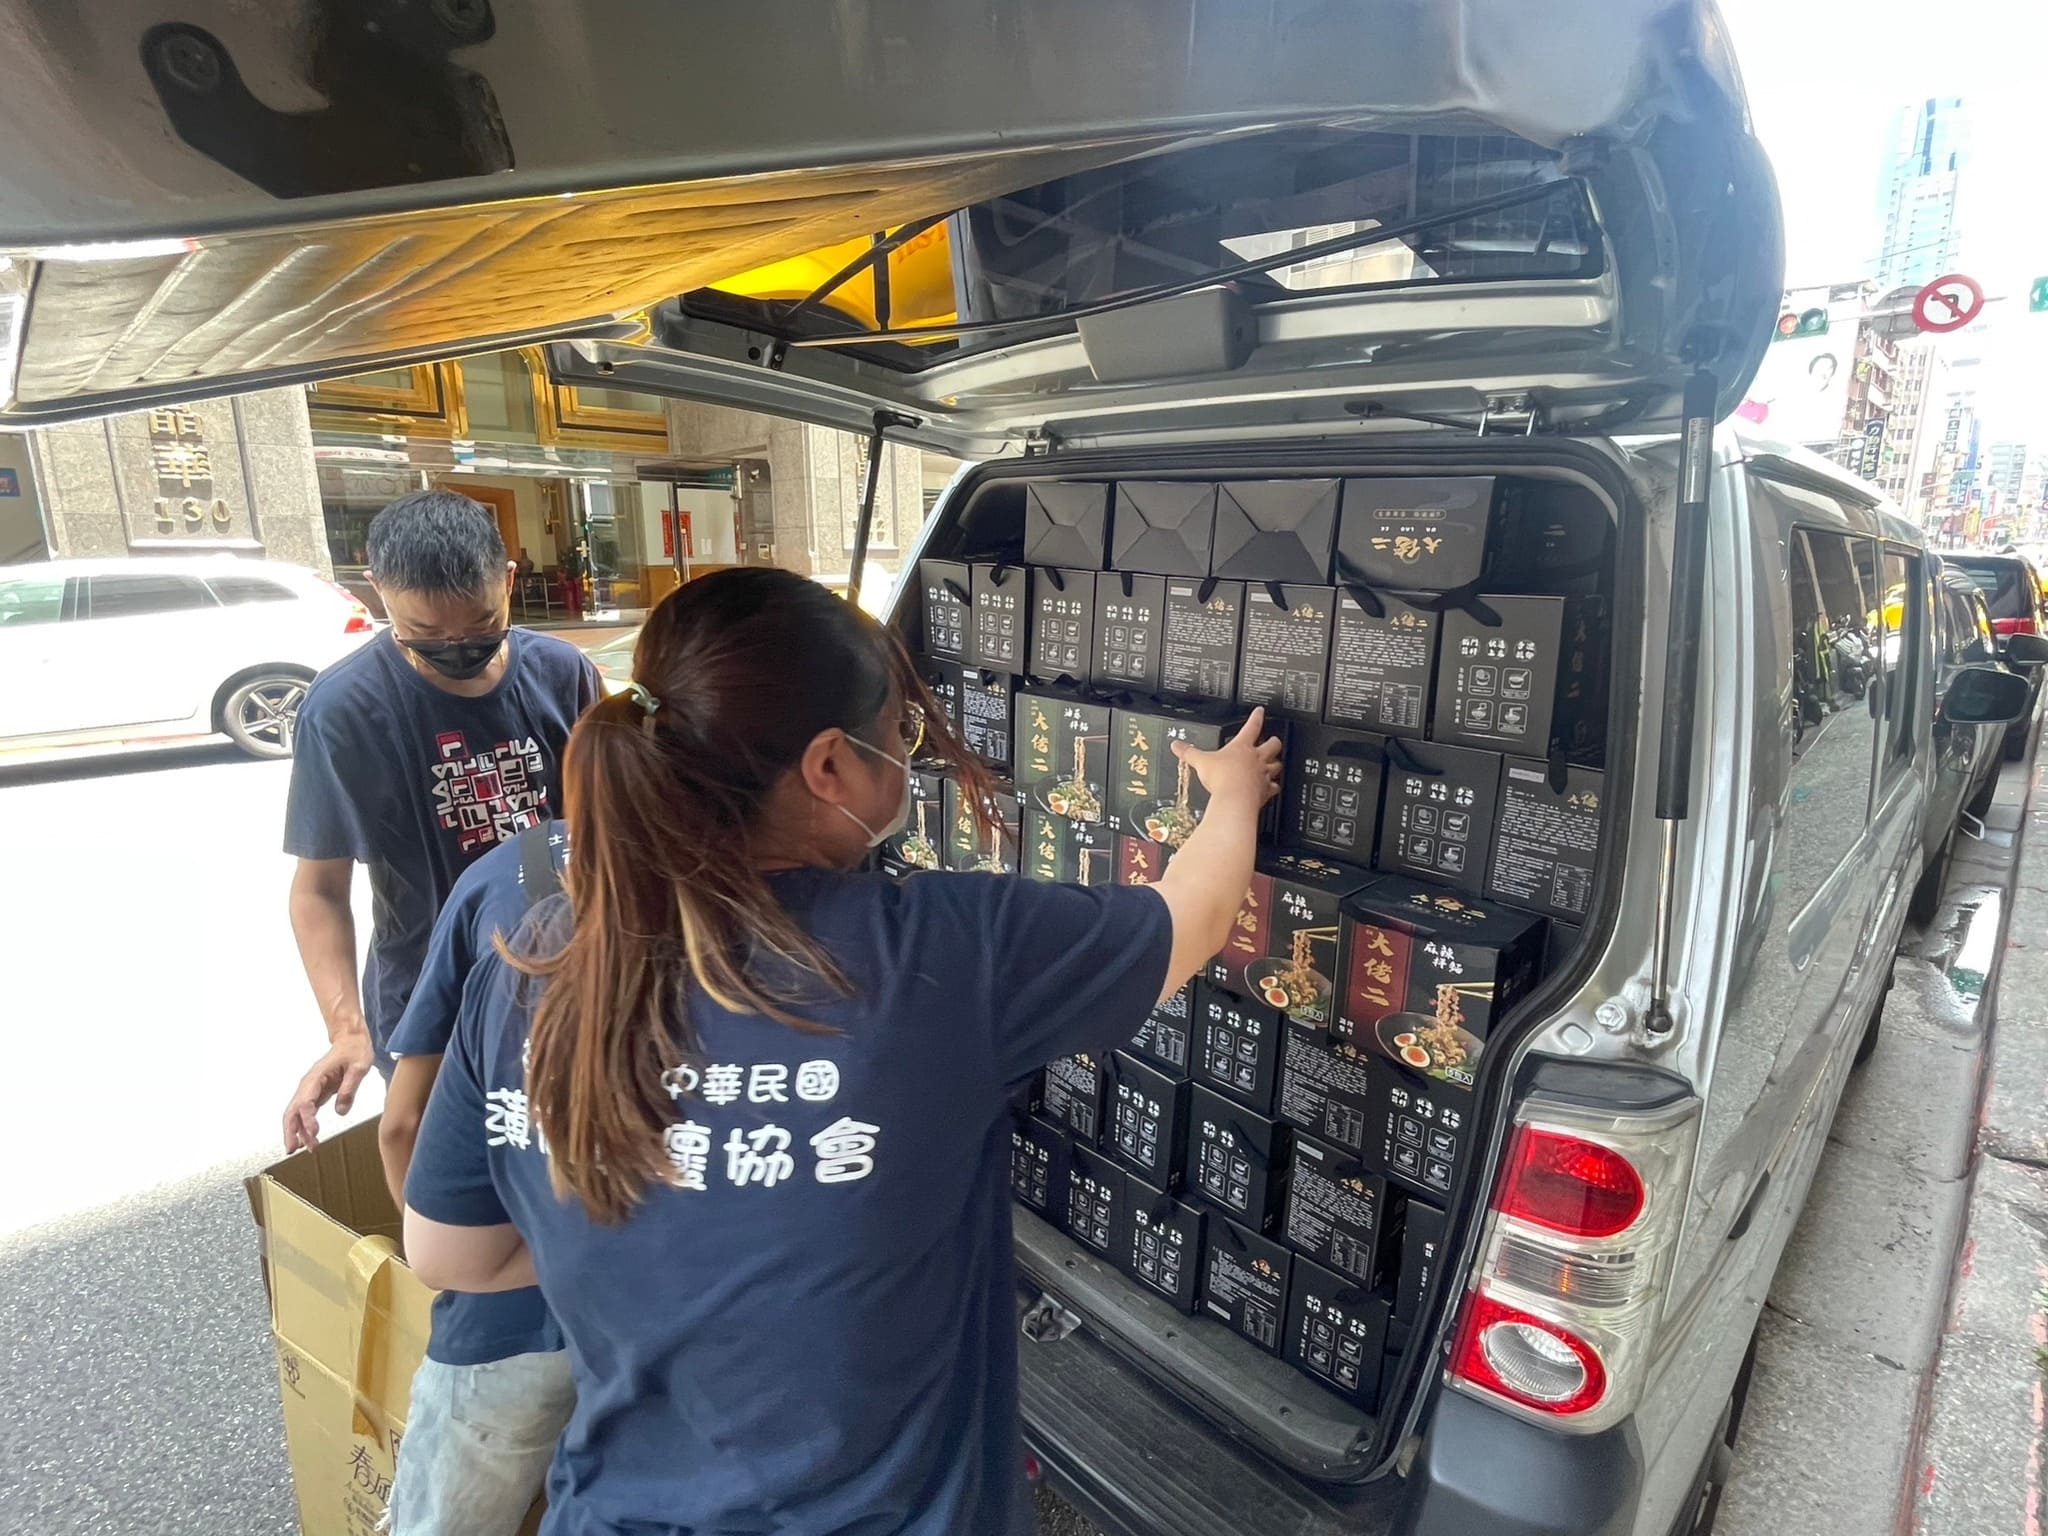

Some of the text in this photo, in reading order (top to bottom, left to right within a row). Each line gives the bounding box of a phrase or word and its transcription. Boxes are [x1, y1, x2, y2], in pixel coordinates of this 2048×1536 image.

[153, 497, 231, 522] 130
[495, 736, 539, 759] FILA
[431, 757, 478, 780] FILA
[432, 780, 458, 829] FILA
[1360, 932, 1395, 1007] 大佬二
[661, 1060, 841, 1105] 中華民國
